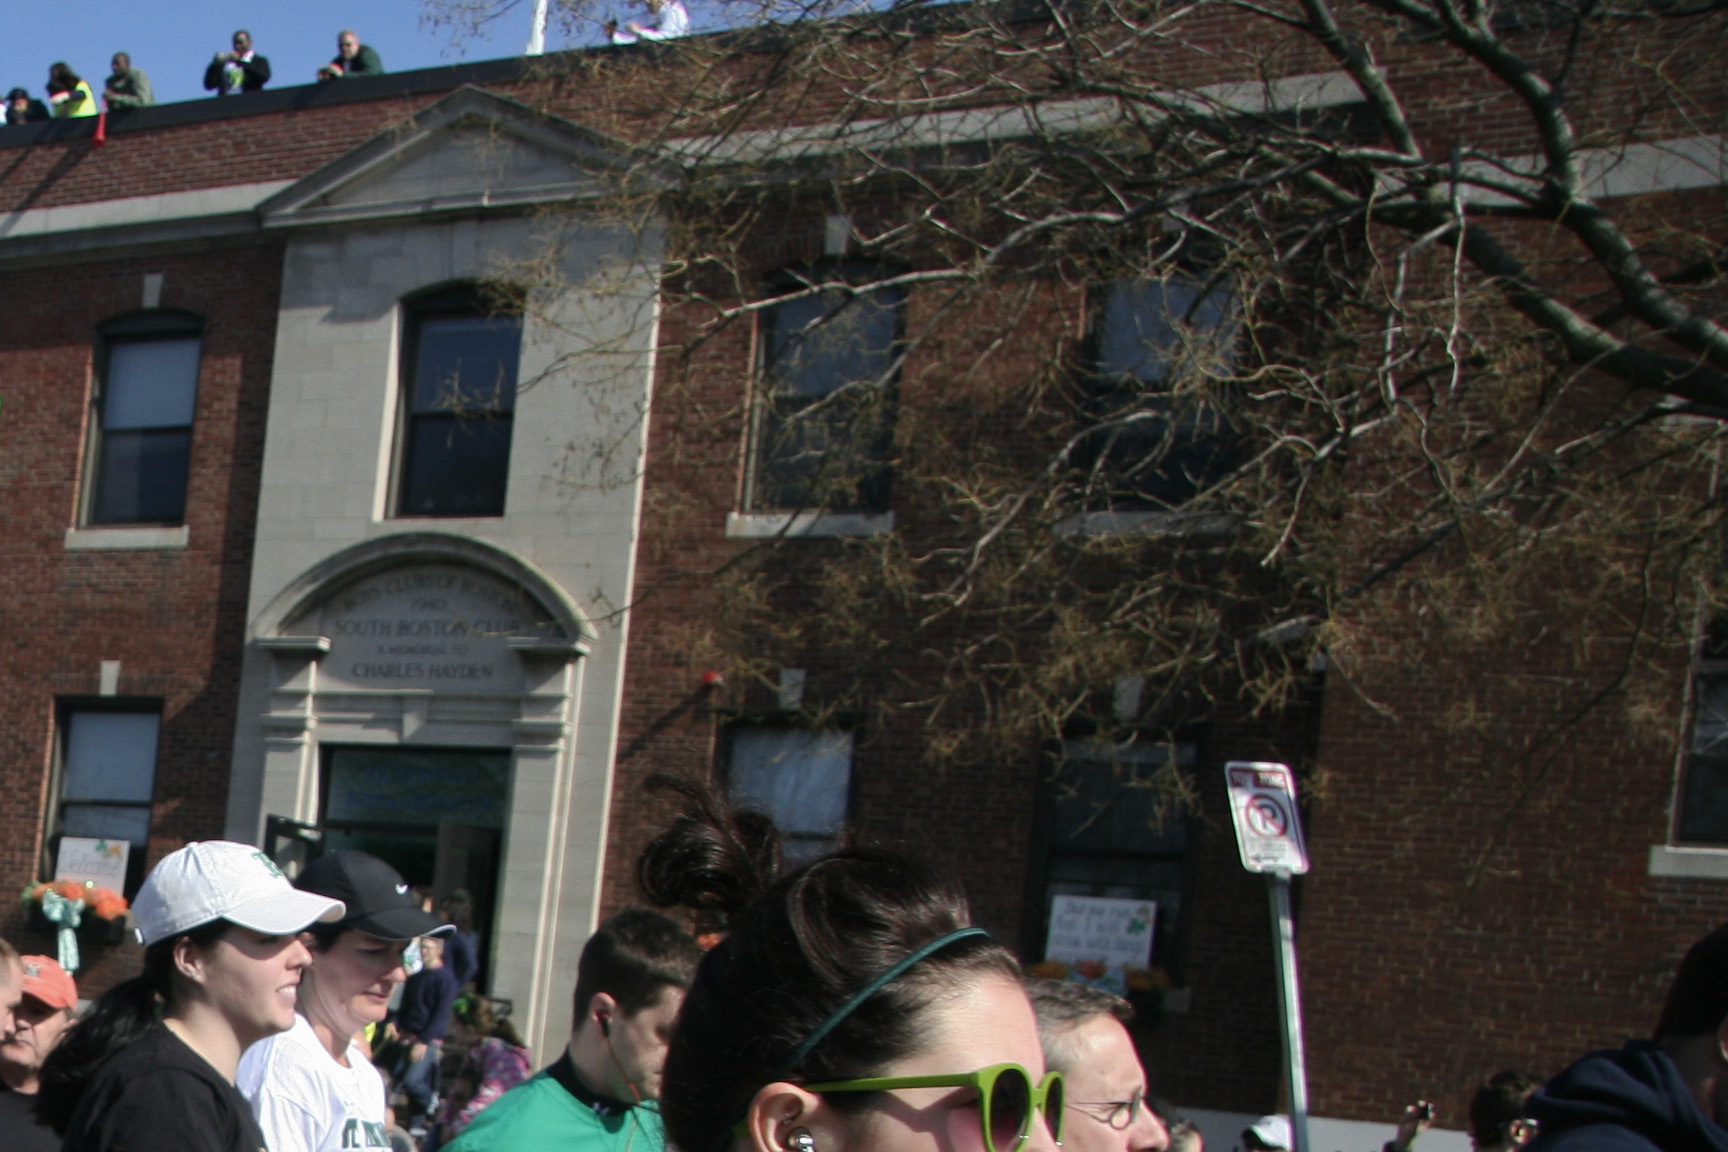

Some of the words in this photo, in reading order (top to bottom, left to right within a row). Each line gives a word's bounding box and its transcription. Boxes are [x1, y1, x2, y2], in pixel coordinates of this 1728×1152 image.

[335, 618, 392, 635] SOUTH
[398, 618, 467, 636] BOSTON
[352, 661, 424, 678] CHARLES
[429, 662, 493, 679] HAYDEN
